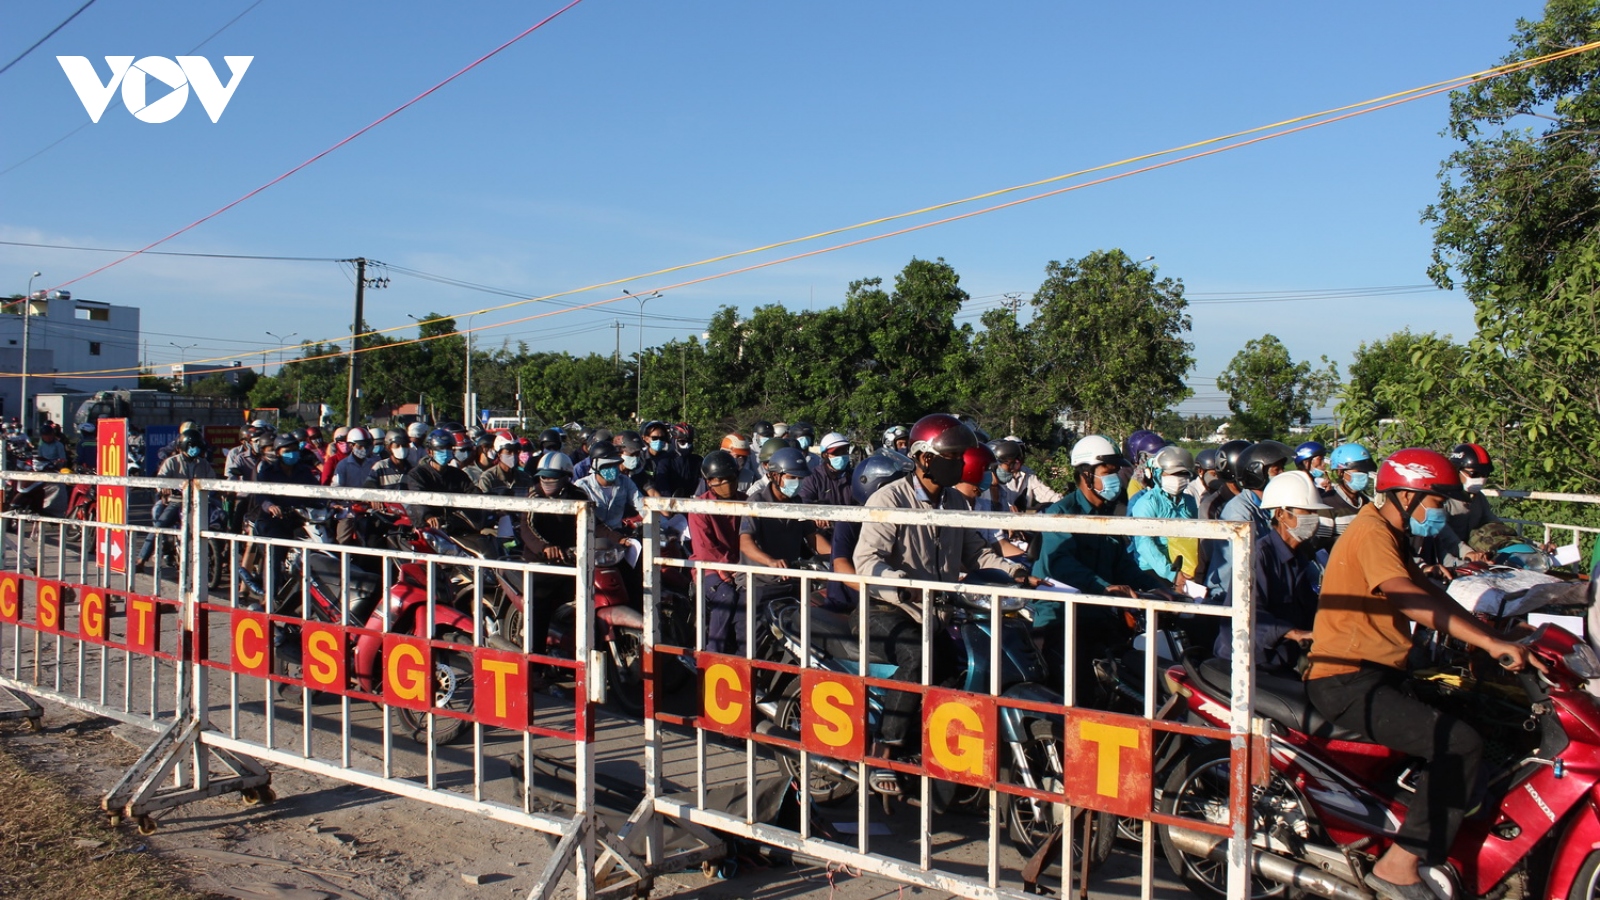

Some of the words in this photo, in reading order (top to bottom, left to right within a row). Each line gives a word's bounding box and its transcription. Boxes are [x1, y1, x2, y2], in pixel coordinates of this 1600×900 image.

[102, 432, 121, 477] LỐI
[100, 489, 123, 533] VÀO
[1524, 782, 1555, 823] HONDA
